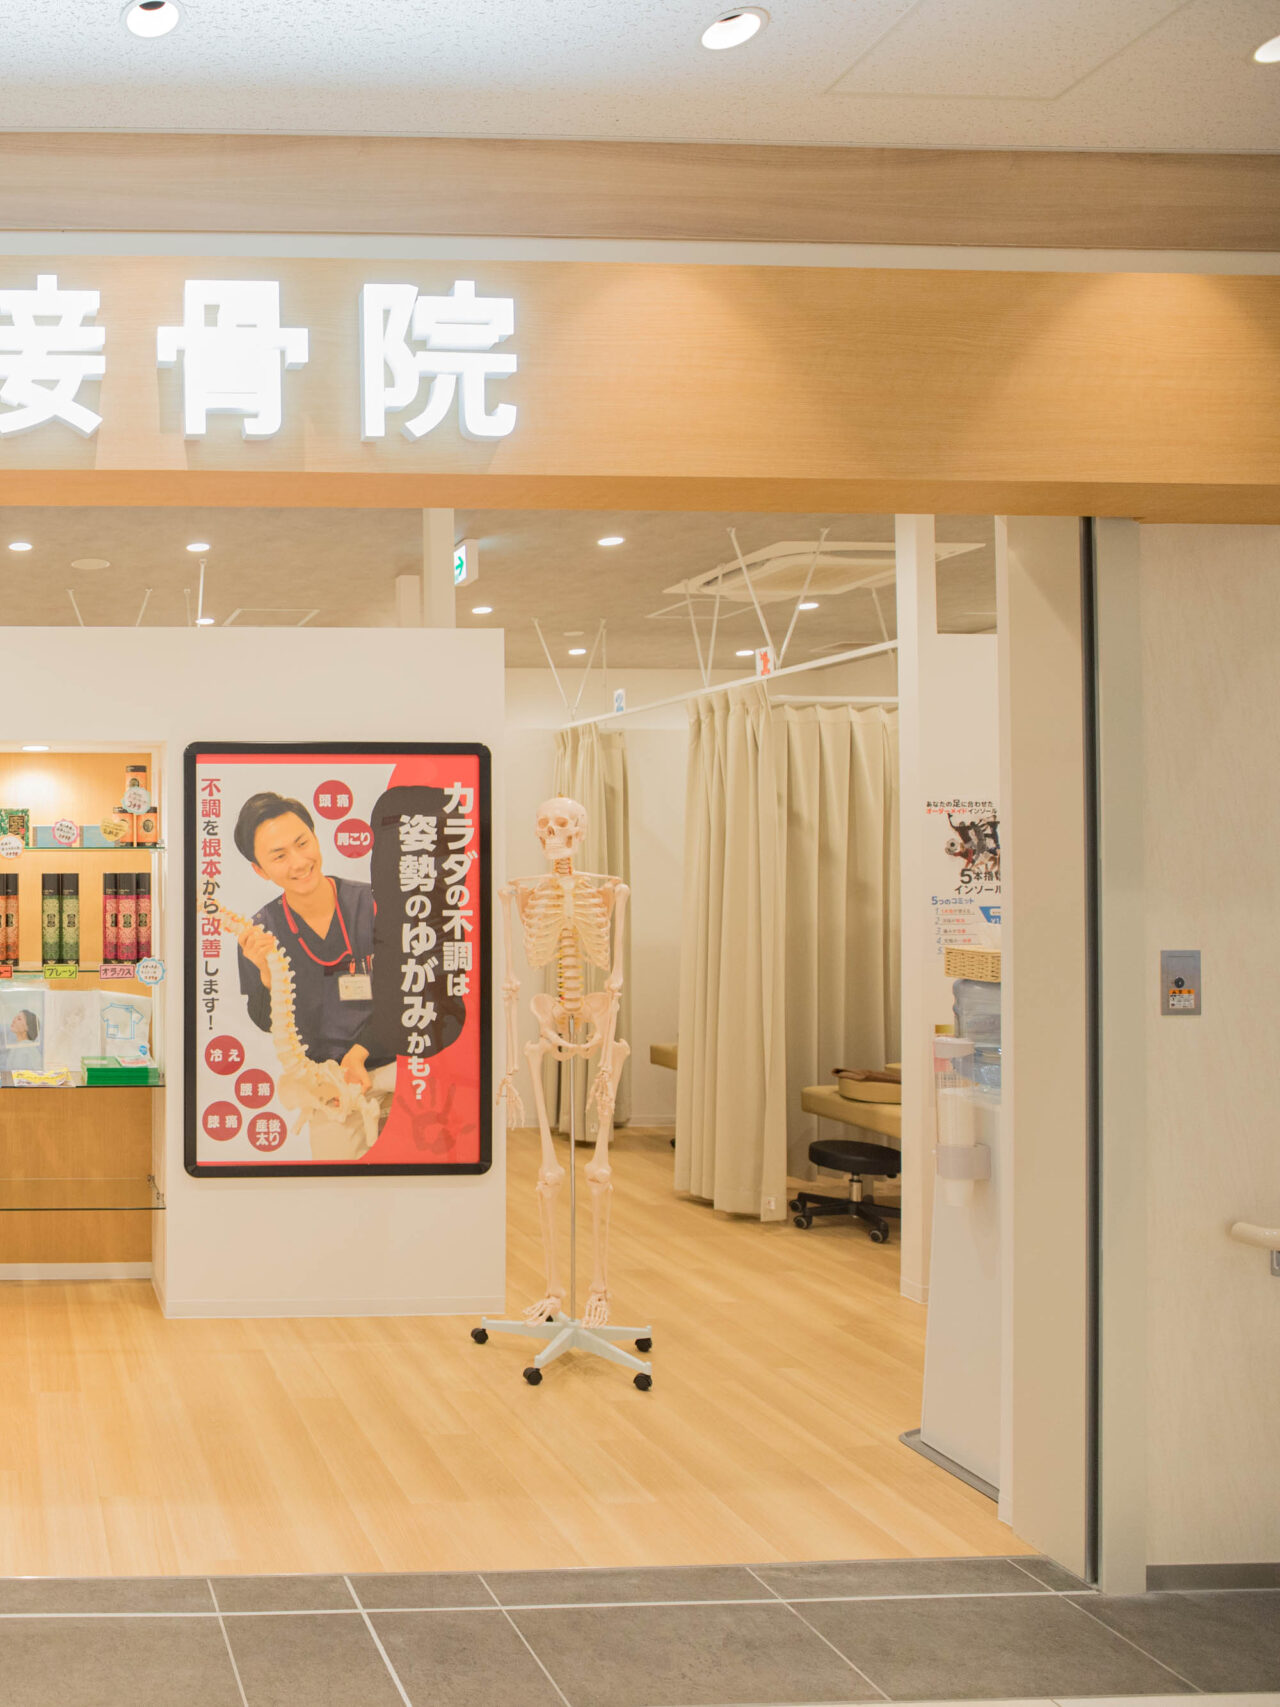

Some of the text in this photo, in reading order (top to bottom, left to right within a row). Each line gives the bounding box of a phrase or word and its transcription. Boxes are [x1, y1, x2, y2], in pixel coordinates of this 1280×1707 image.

[926, 799, 994, 808] あなたの足に合わせた
[336, 832, 371, 847] 肩こり
[441, 781, 478, 997] カラダの不調は
[200, 777, 222, 1031] 不調を根本から改善します!
[398, 814, 439, 1100] 姿勢のゆがみかも?
[209, 1048, 240, 1063] 冷え
[255, 1119, 281, 1132] 産後
[255, 1132, 280, 1146] 太り
